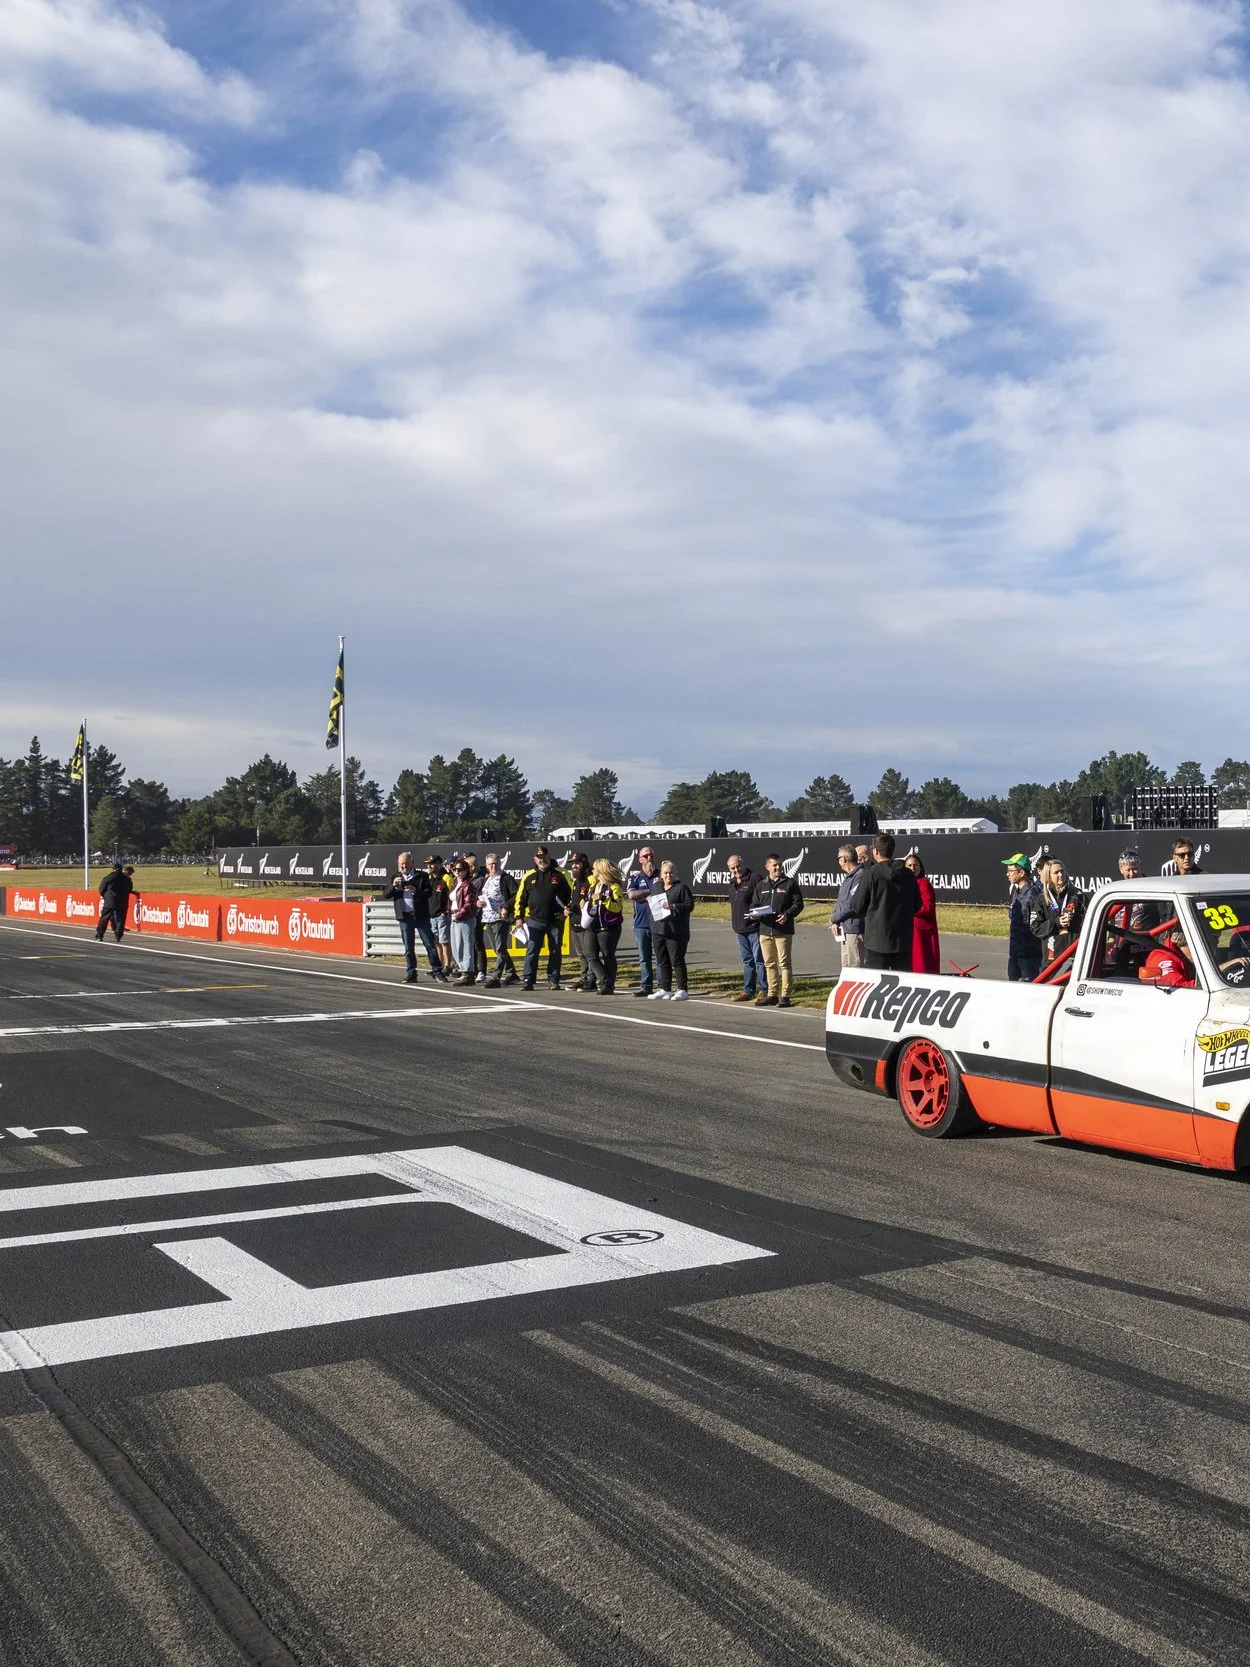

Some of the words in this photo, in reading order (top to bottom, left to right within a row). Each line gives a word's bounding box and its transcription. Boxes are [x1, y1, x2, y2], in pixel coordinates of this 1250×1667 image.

[706, 871, 722, 884] NEW
[798, 872, 816, 886] NEW
[237, 912, 279, 936] Christchurch
[1203, 905, 1239, 930] 33
[860, 973, 971, 1033] Repco
